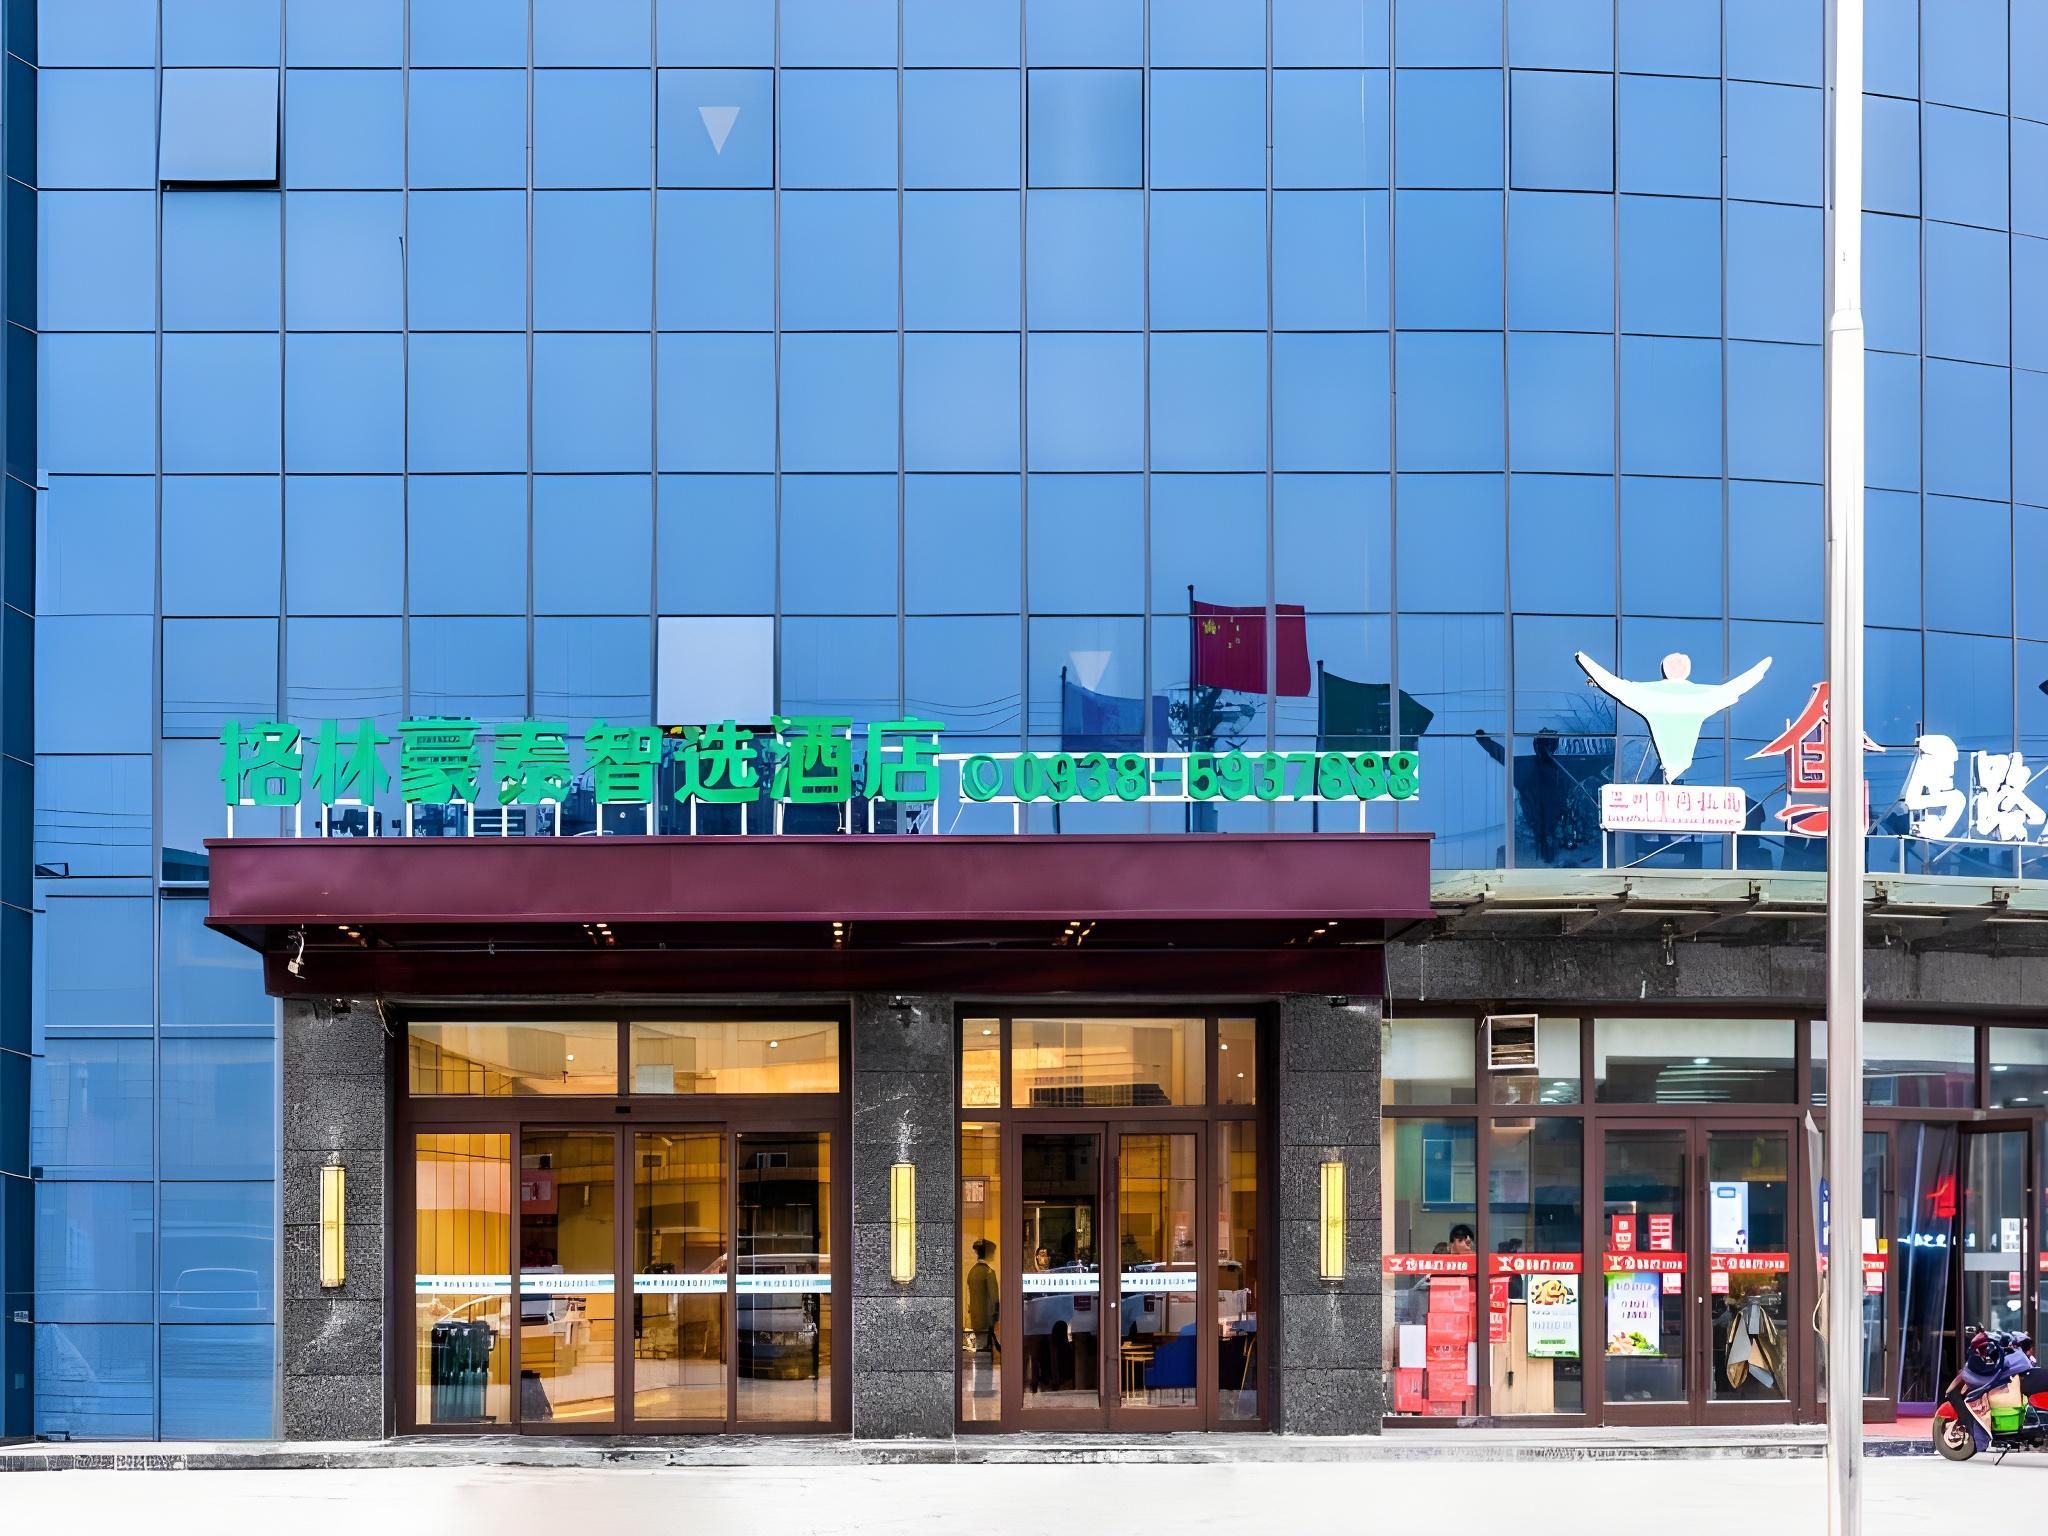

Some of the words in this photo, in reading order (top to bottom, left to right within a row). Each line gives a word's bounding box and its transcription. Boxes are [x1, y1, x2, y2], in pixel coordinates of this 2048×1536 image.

[219, 715, 946, 805] 格林豪泰智选酒店
[1013, 751, 1418, 802] 0938-5937888
